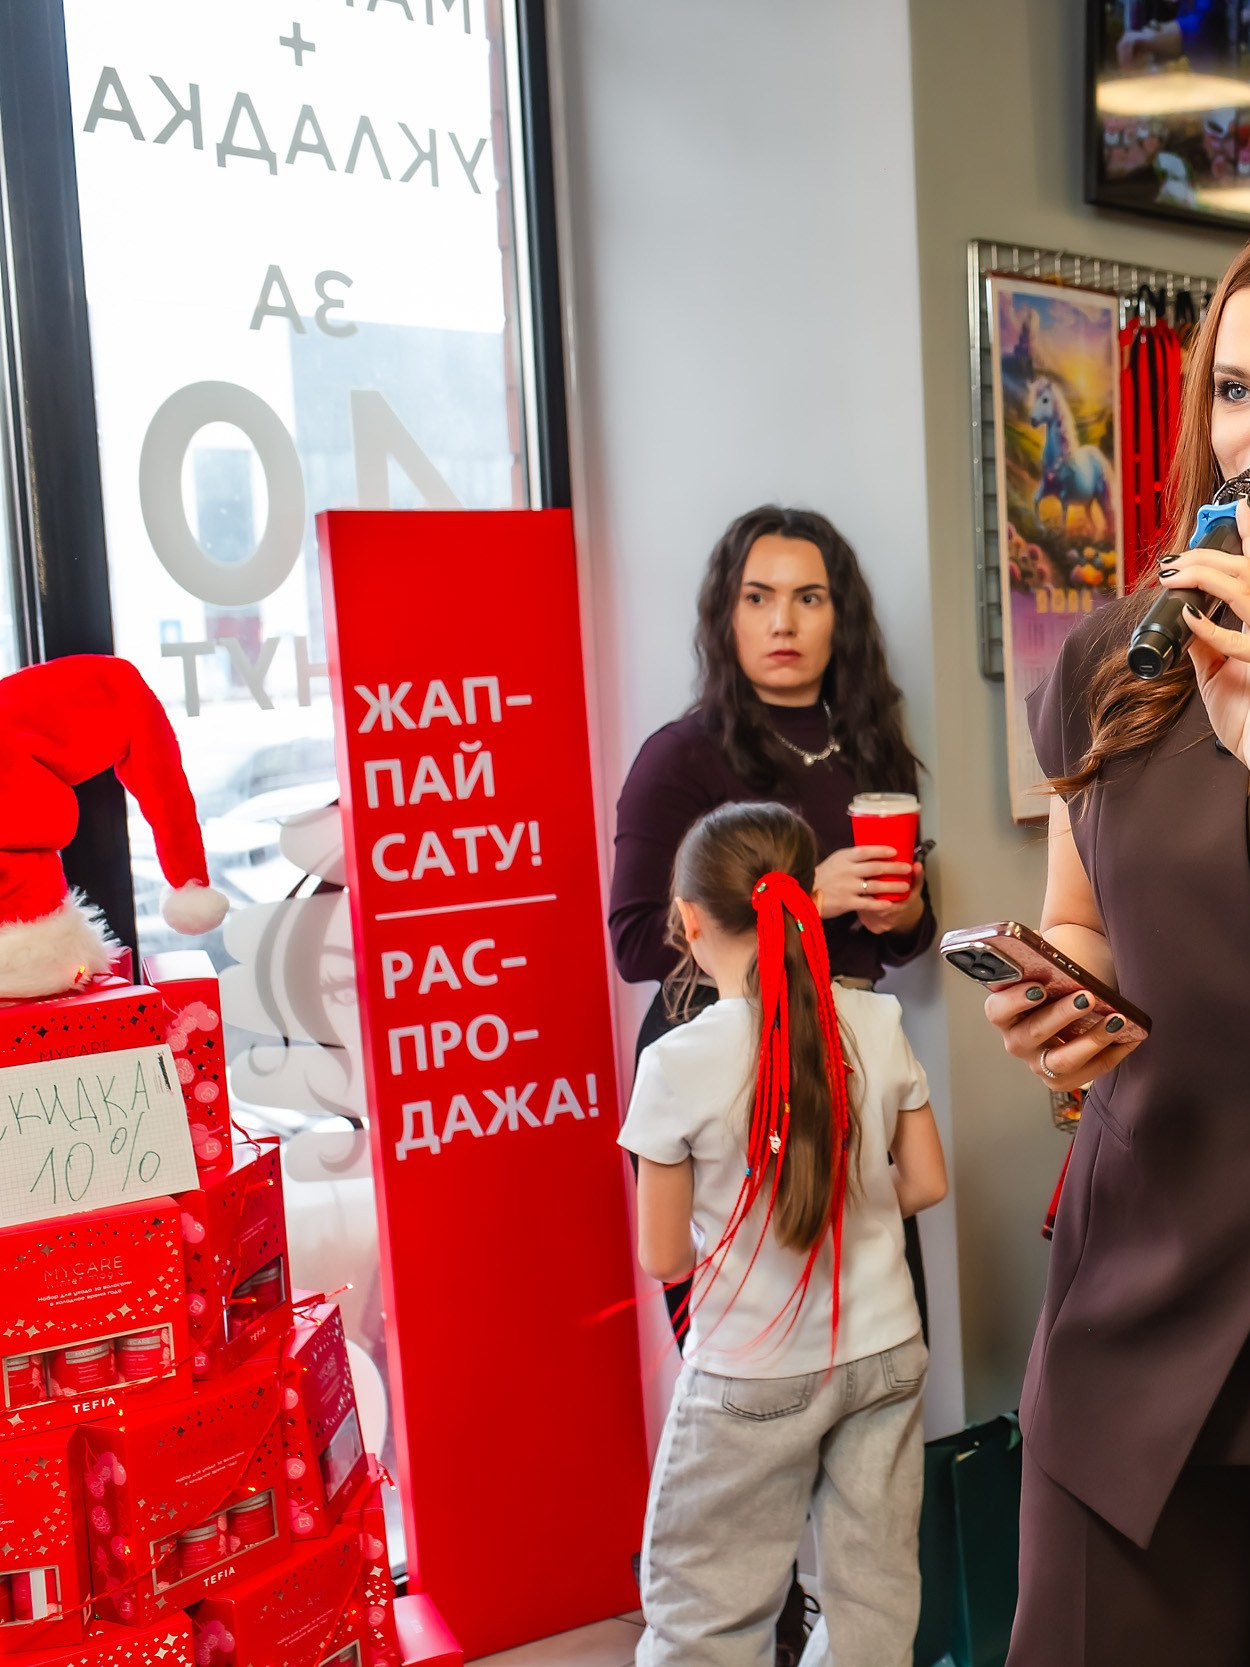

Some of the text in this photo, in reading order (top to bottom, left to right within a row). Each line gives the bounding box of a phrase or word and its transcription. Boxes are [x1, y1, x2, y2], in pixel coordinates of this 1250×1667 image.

[354, 675, 532, 733] ЖАП-
[364, 740, 495, 809] ПАЙ
[371, 820, 542, 882] САТУ!
[381, 938, 527, 999] РАС-
[388, 1014, 539, 1075] ПРО-
[0, 1060, 150, 1141] КИДКА
[395, 1073, 599, 1161] ДАЖА!
[30, 1111, 161, 1204] 10%
[44, 1255, 123, 1281] MYCARE
[72, 1397, 116, 1414] TEFIA
[203, 1566, 236, 1587] TEFIA
